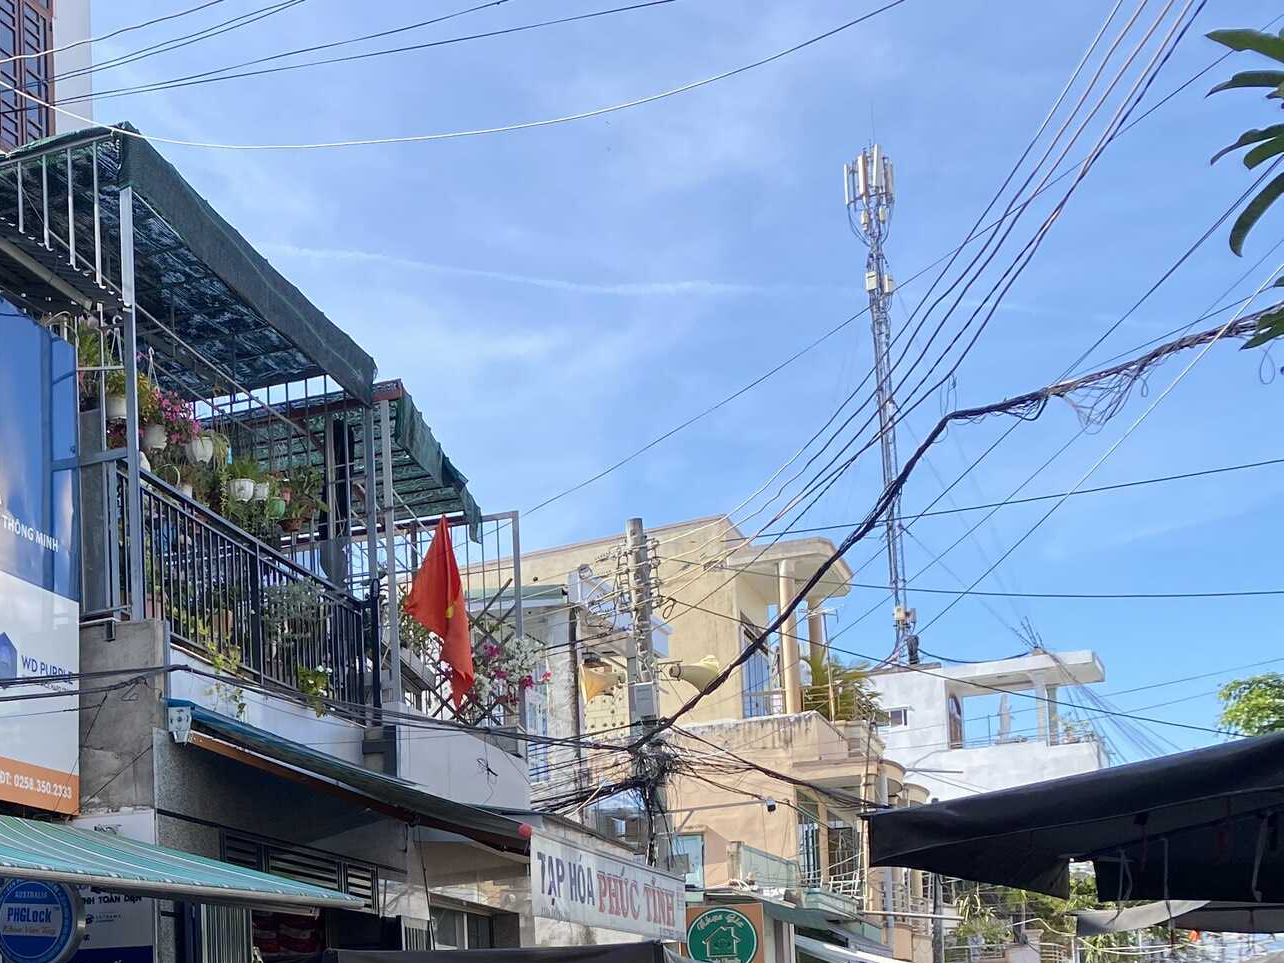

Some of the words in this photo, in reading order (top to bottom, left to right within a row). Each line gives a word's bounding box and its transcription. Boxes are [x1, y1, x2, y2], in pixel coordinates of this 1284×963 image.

[1, 514, 34, 542] THÔNG
[35, 530, 59, 553] MINH
[21, 654, 38, 673] WD
[536, 851, 565, 906] TẠP
[568, 854, 596, 906] HÓA
[597, 866, 641, 921] PHÚC
